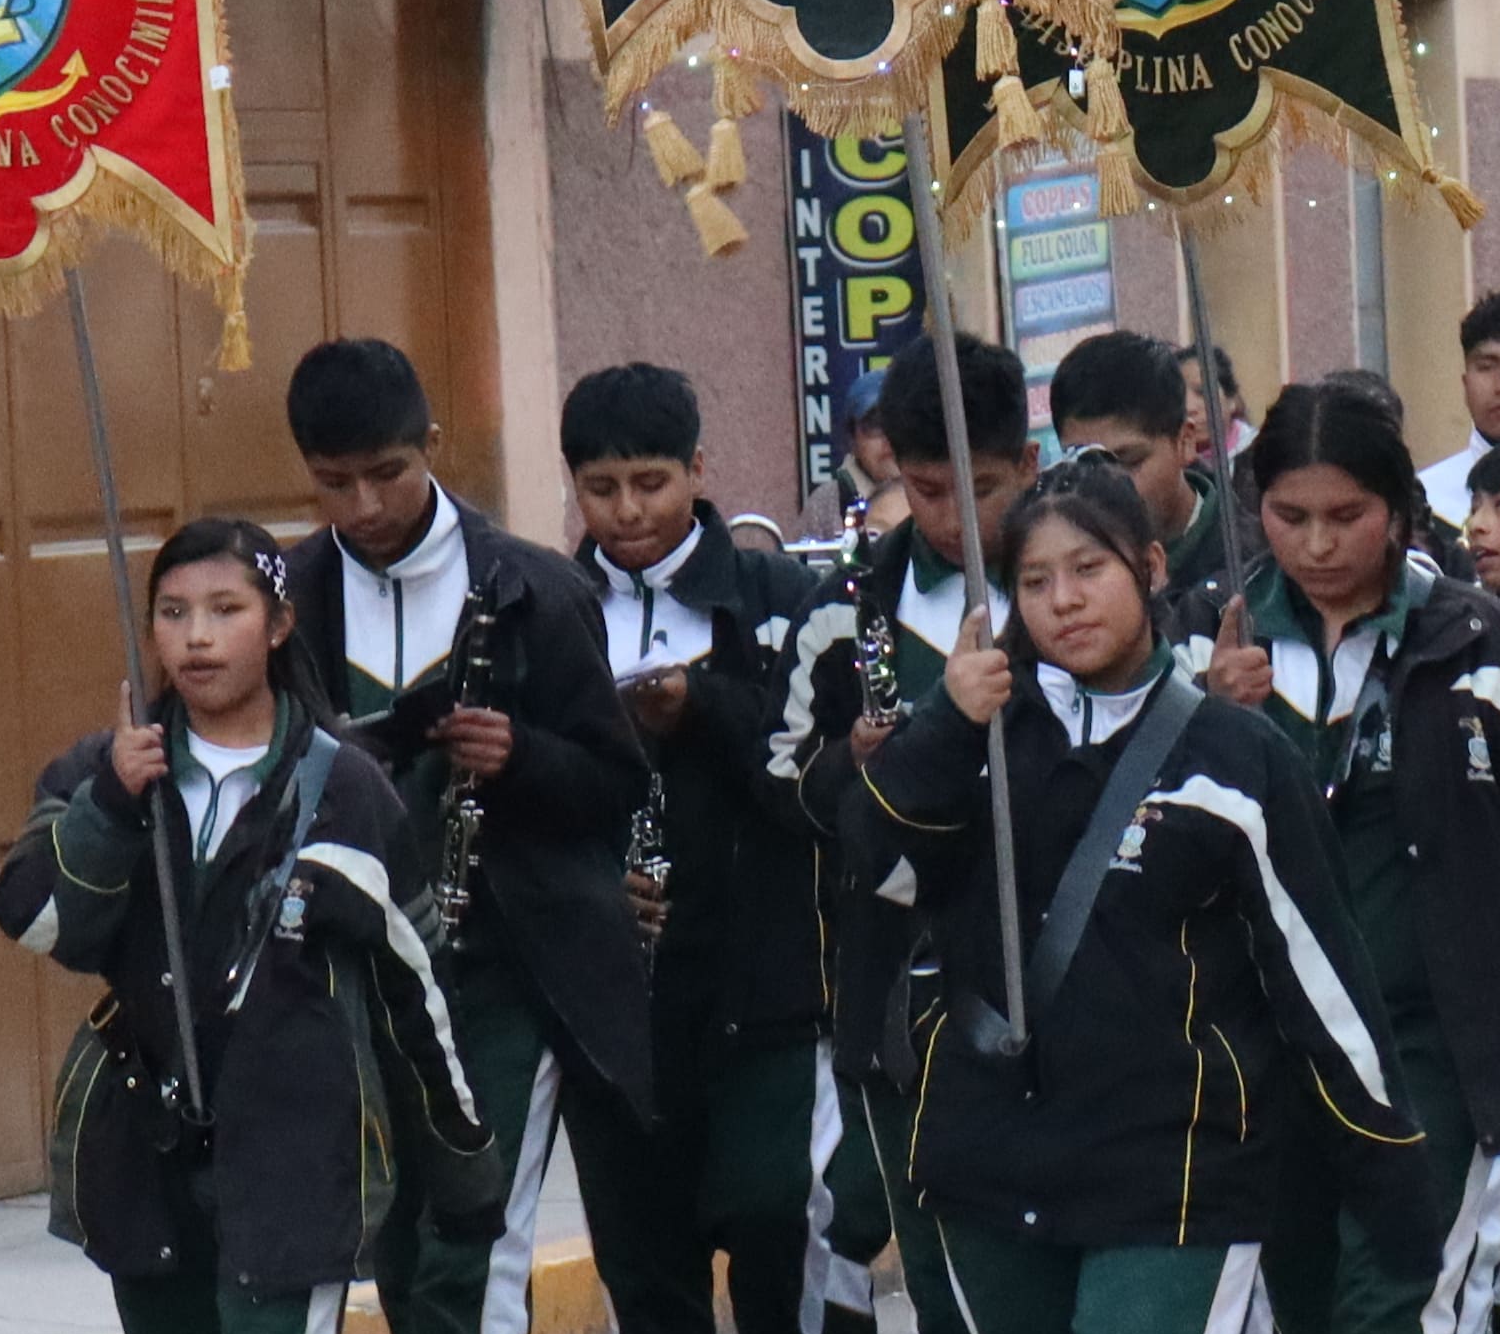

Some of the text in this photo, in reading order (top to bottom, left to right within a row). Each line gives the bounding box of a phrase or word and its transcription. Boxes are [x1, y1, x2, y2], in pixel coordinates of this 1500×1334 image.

[825, 118, 914, 373] COP
[1021, 228, 1098, 266] FULL COLOR
[1022, 184, 1091, 219] COPIAS
[795, 149, 836, 483] INTERNE
